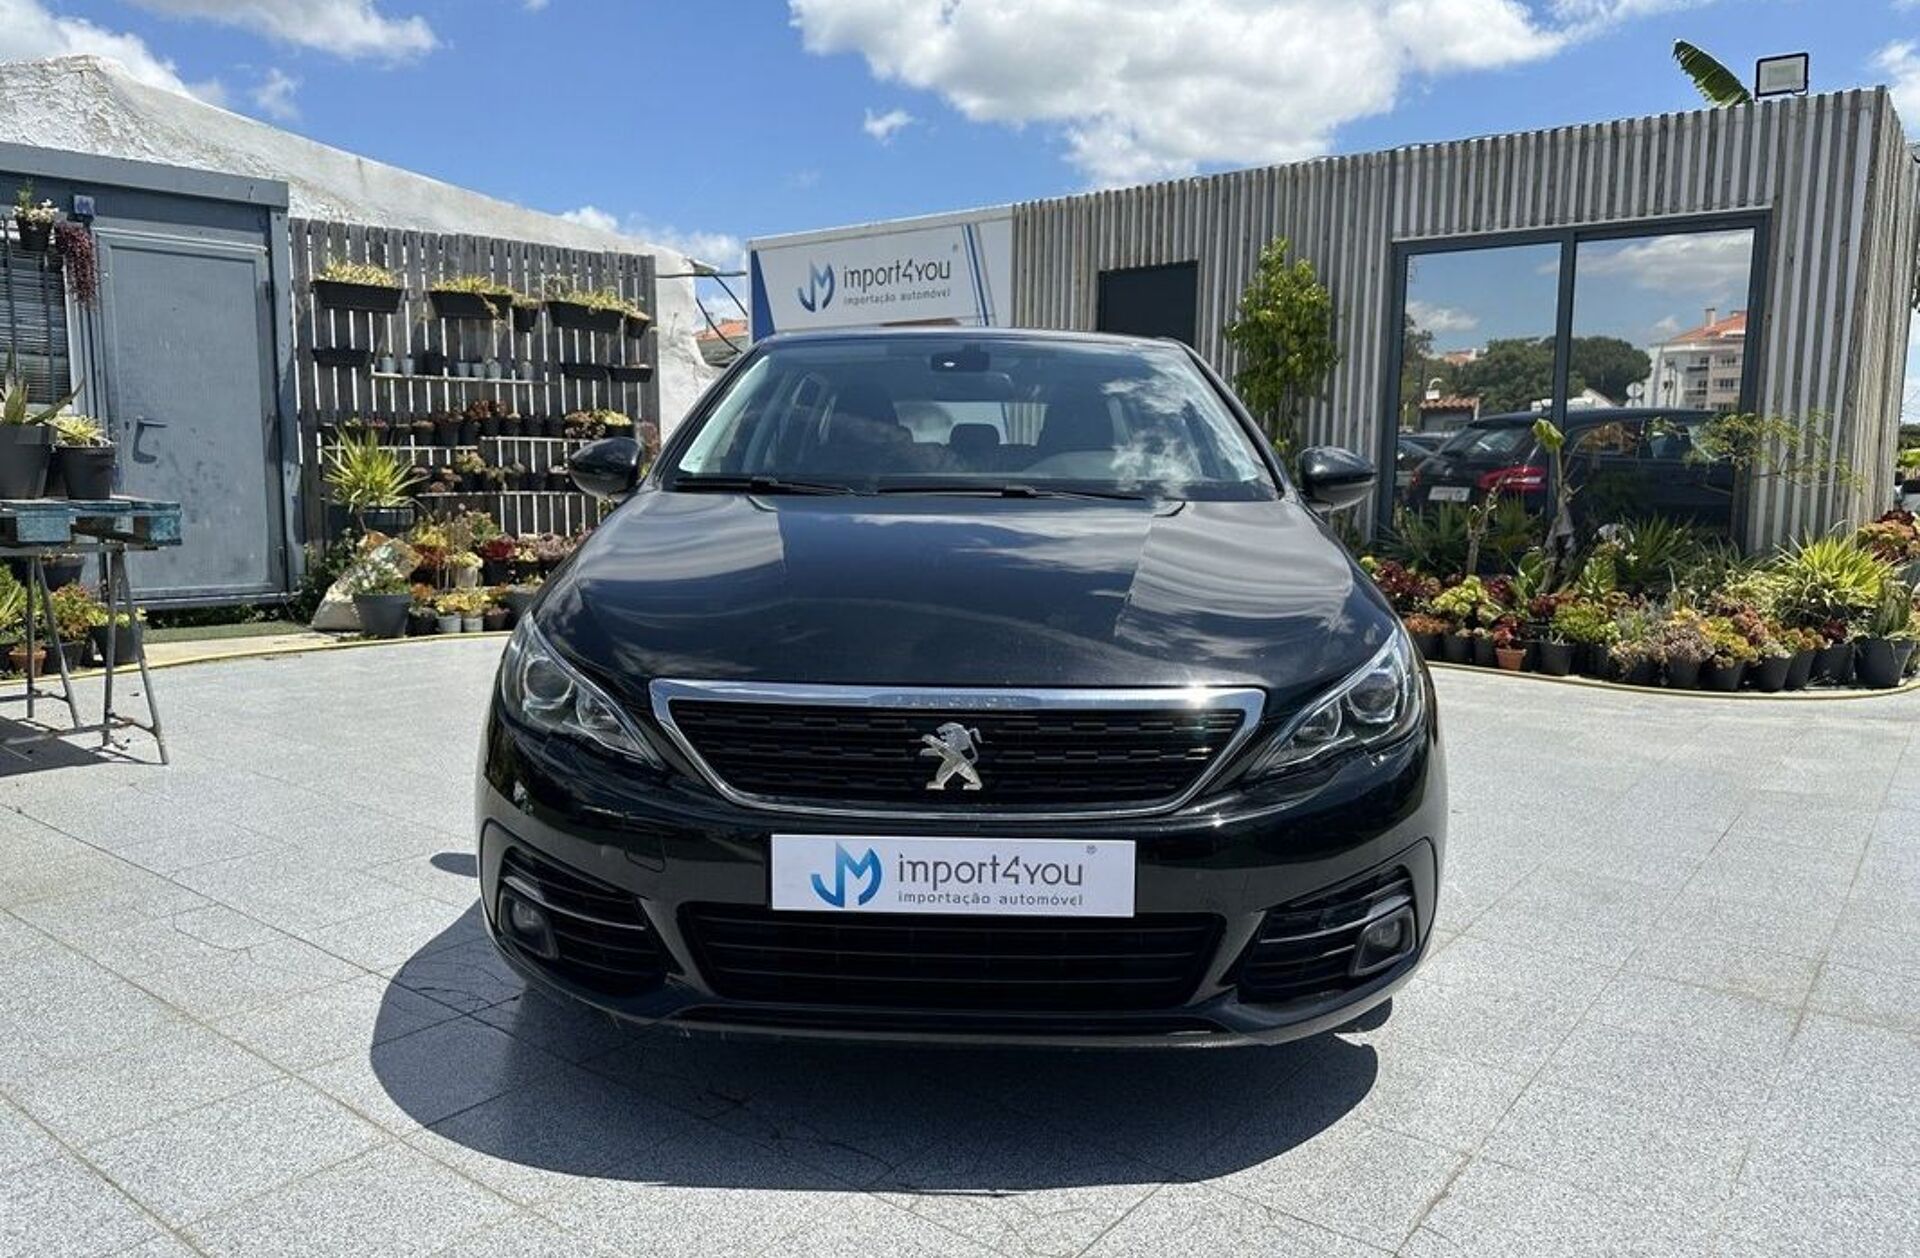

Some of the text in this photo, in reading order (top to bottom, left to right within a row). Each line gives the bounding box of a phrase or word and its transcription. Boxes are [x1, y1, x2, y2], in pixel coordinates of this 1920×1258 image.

[844, 258, 950, 293] import4you
[898, 854, 1083, 891] import4you
[898, 892, 1083, 908] importação automóvel
